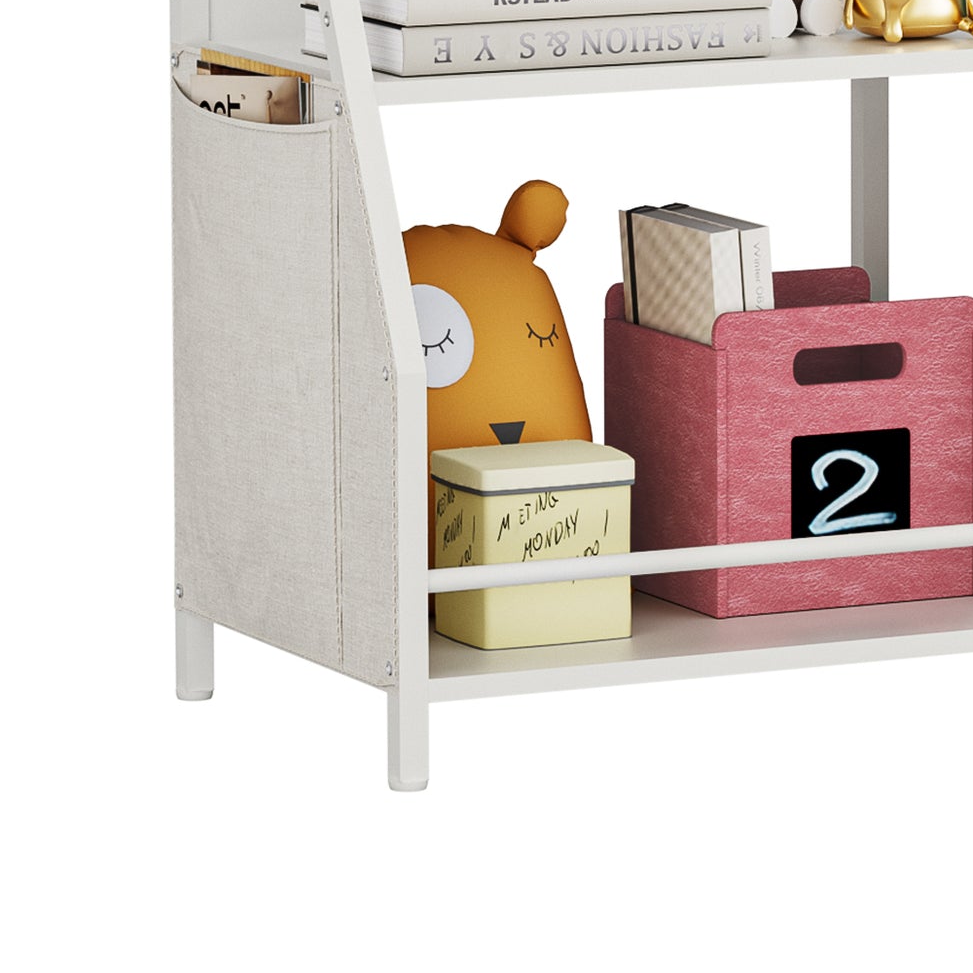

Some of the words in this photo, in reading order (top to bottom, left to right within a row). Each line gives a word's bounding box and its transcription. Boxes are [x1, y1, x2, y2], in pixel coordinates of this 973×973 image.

[547, 29, 570, 57] &
[581, 22, 726, 56] FASHION
[753, 242, 761, 282] Winter
[808, 448, 897, 536] 2
[522, 507, 580, 563] MONDAY
